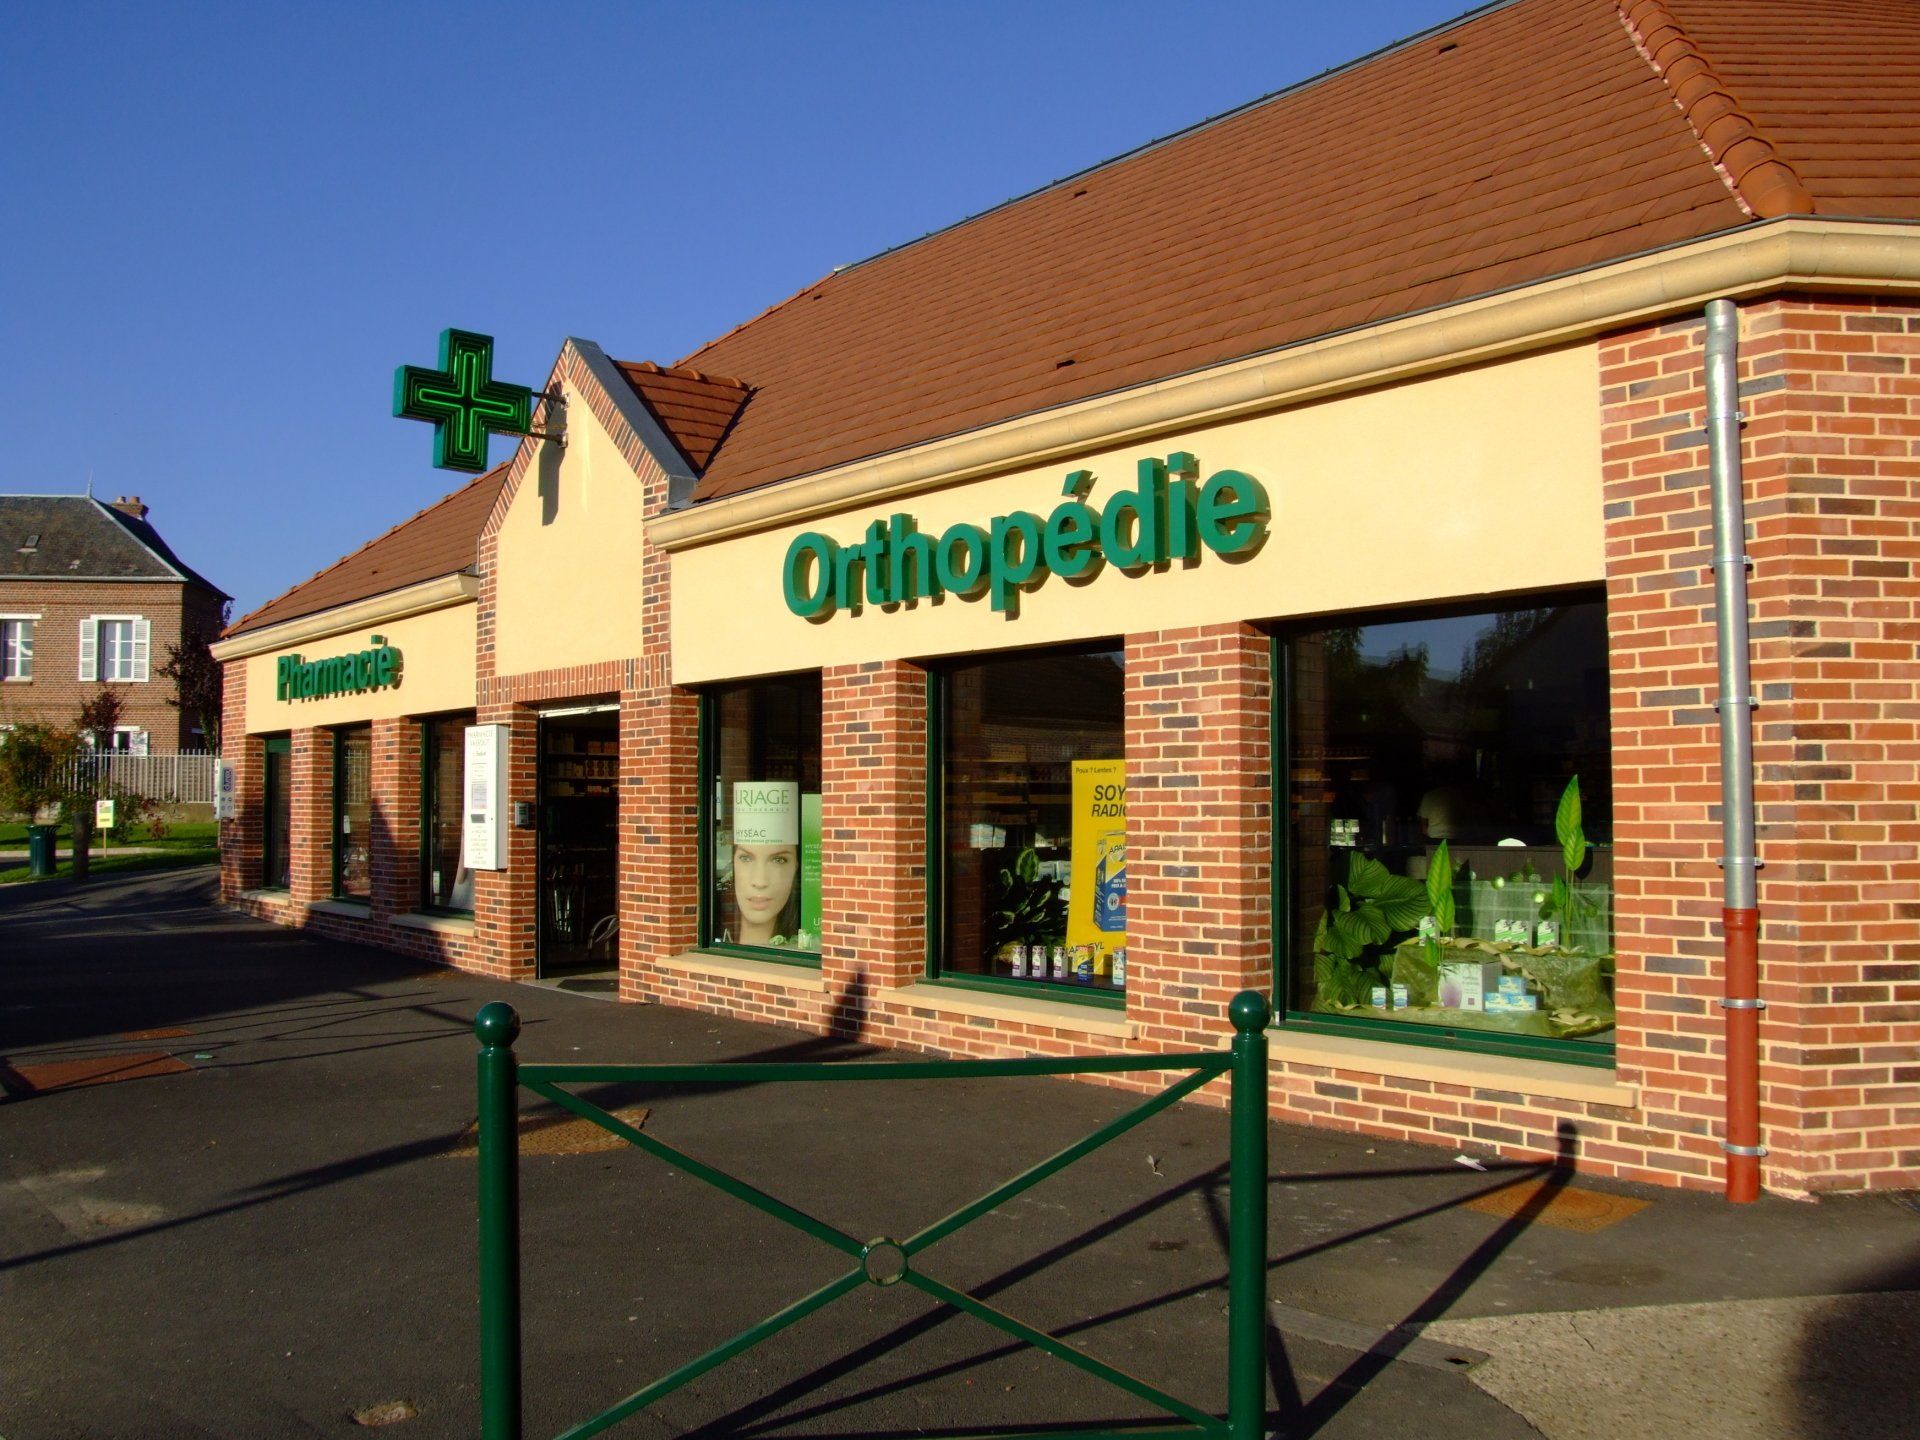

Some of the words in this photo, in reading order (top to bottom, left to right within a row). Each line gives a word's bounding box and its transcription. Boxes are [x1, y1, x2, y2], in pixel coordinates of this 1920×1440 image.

[783, 451, 1270, 617] Orthopédie
[277, 634, 400, 702] Pharmacie
[735, 789, 790, 807] URIAGE
[1094, 784, 1126, 801] SOY
